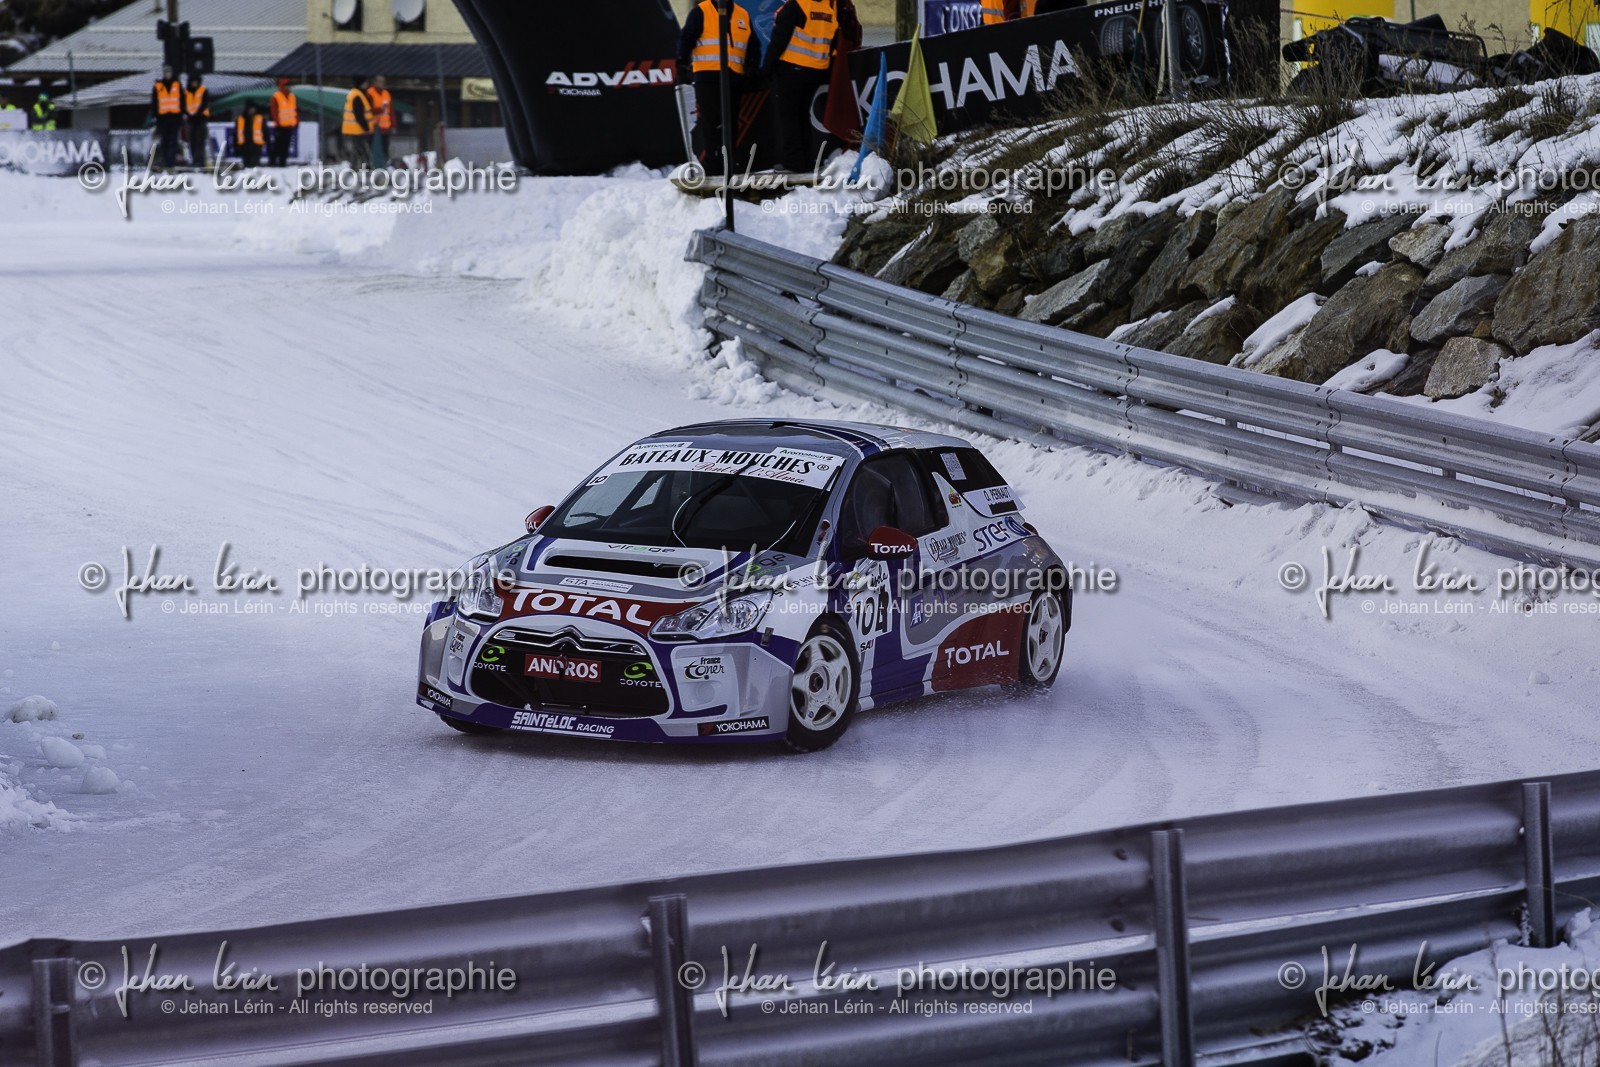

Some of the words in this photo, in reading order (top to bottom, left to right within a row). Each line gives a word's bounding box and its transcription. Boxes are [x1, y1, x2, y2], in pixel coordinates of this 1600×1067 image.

[1094, 2, 1143, 17] PNEUS
[546, 68, 673, 87] ADVAN
[558, 87, 602, 96] YOKOHAMA
[589, 476, 608, 485] 10
[608, 544, 676, 553] virage
[870, 543, 914, 554] TOTAL
[509, 588, 652, 627] TOTAL
[944, 640, 1010, 669] TOTAL
[473, 661, 507, 672] COYOTE
[619, 678, 663, 688] COYOTE
[427, 687, 452, 706] YOKOHAMA
[576, 723, 615, 734] RACING
[716, 719, 768, 732] YOKOHAMA
